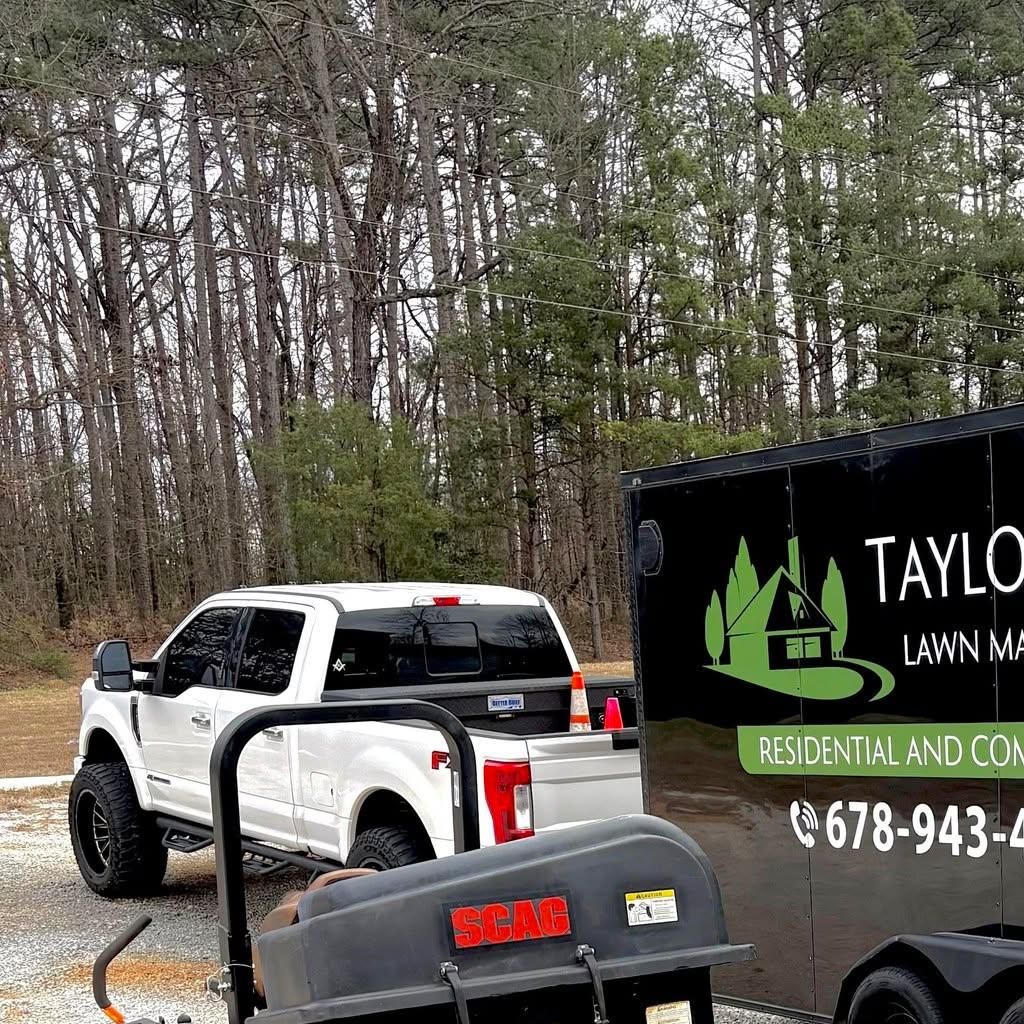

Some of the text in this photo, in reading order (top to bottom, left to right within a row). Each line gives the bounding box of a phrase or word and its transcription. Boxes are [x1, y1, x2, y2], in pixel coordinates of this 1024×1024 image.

[903, 629, 979, 666] LAWN
[759, 735, 899, 767] RESIDENTIAL
[906, 735, 963, 767] AND
[451, 895, 571, 949] SCAG
